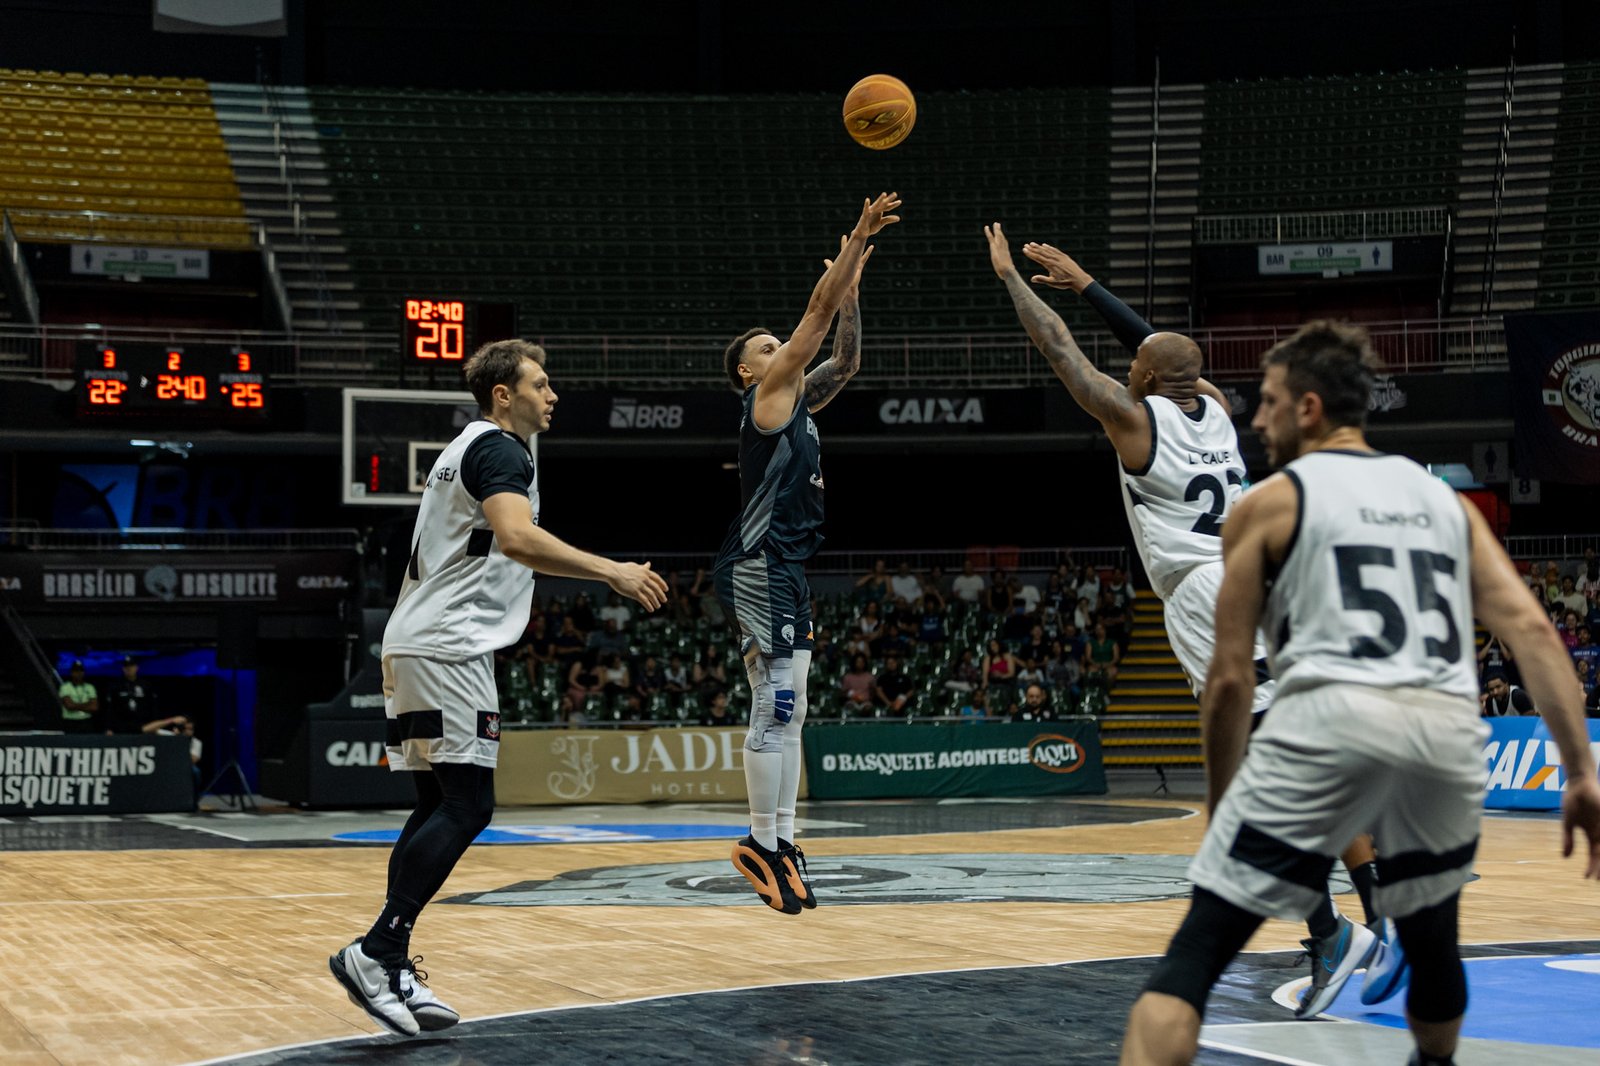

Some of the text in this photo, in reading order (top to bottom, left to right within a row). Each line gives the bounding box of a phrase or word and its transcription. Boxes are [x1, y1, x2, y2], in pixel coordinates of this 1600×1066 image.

[1266, 254, 1285, 266] BAR
[1317, 246, 1333, 257] 09
[406, 299, 464, 321] 02:40
[416, 322, 464, 359] 20
[103, 350, 116, 369] 3
[167, 352, 182, 371] 2
[237, 353, 251, 371] 3
[89, 378, 122, 404] 22
[157, 374, 207, 400] 2:40
[231, 383, 264, 407] 25
[635, 404, 684, 429] BRB
[878, 398, 985, 424] CAIXA
[1519, 479, 1531, 494] 8
[1184, 468, 1242, 537] 2
[182, 573, 277, 598] BASQUETE
[1333, 545, 1461, 664] 55
[822, 743, 1079, 776] O BASQUETE ACONTECE AQUI
[652, 782, 726, 796] HOTEL
